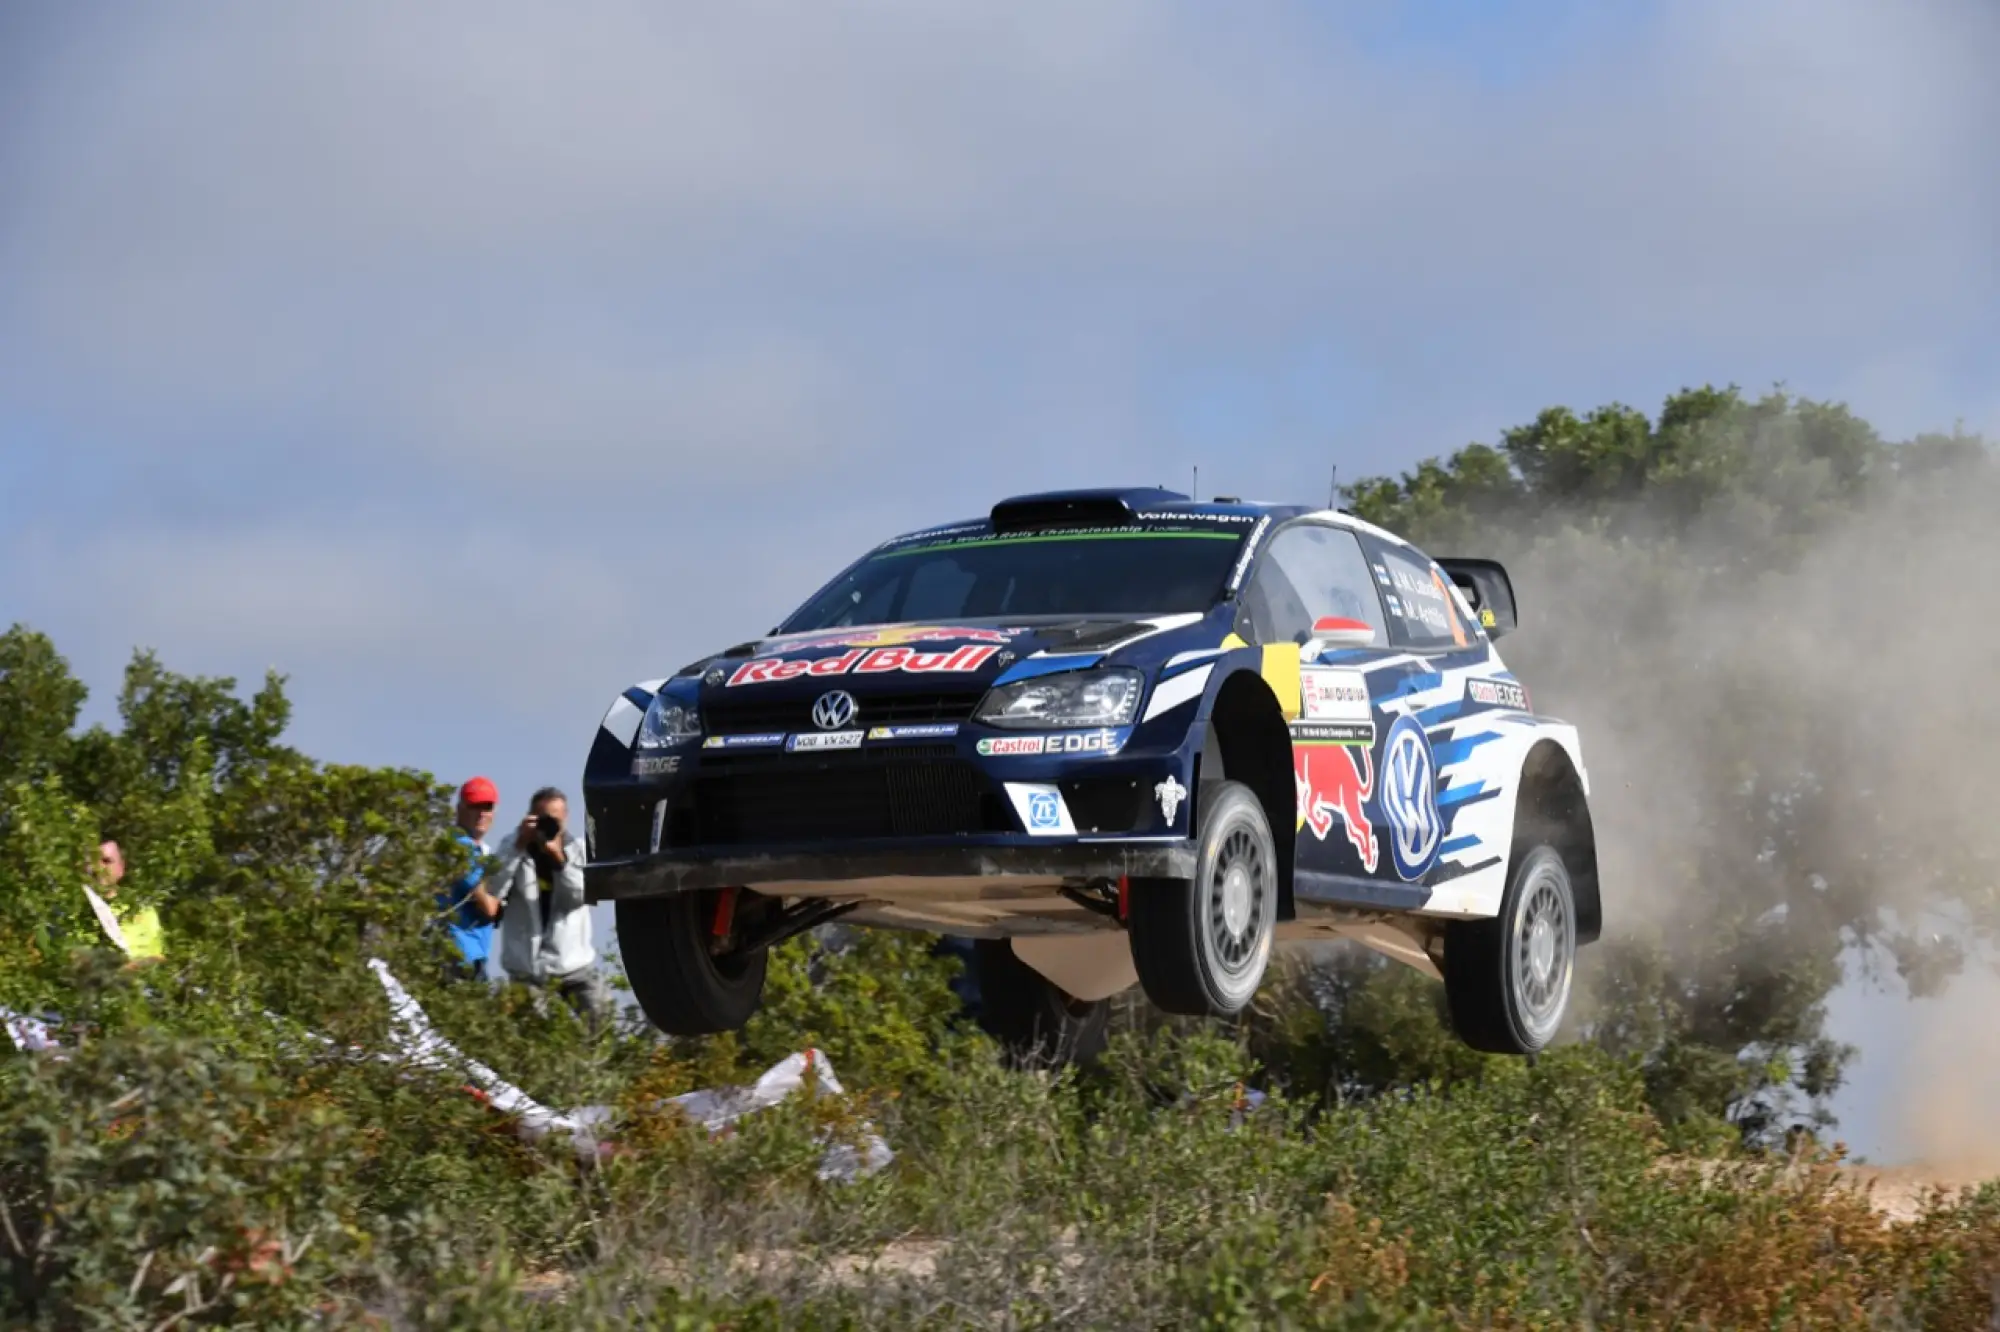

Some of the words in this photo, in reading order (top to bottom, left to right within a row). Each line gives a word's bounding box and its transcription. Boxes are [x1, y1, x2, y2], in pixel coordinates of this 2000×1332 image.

[1137, 512, 1254, 523] Volkswagen
[1039, 525, 1143, 537] Championship
[725, 649, 868, 687] Red
[853, 645, 1002, 673] Bull
[992, 737, 1042, 753] Castrol
[1046, 730, 1118, 753] EDGE
